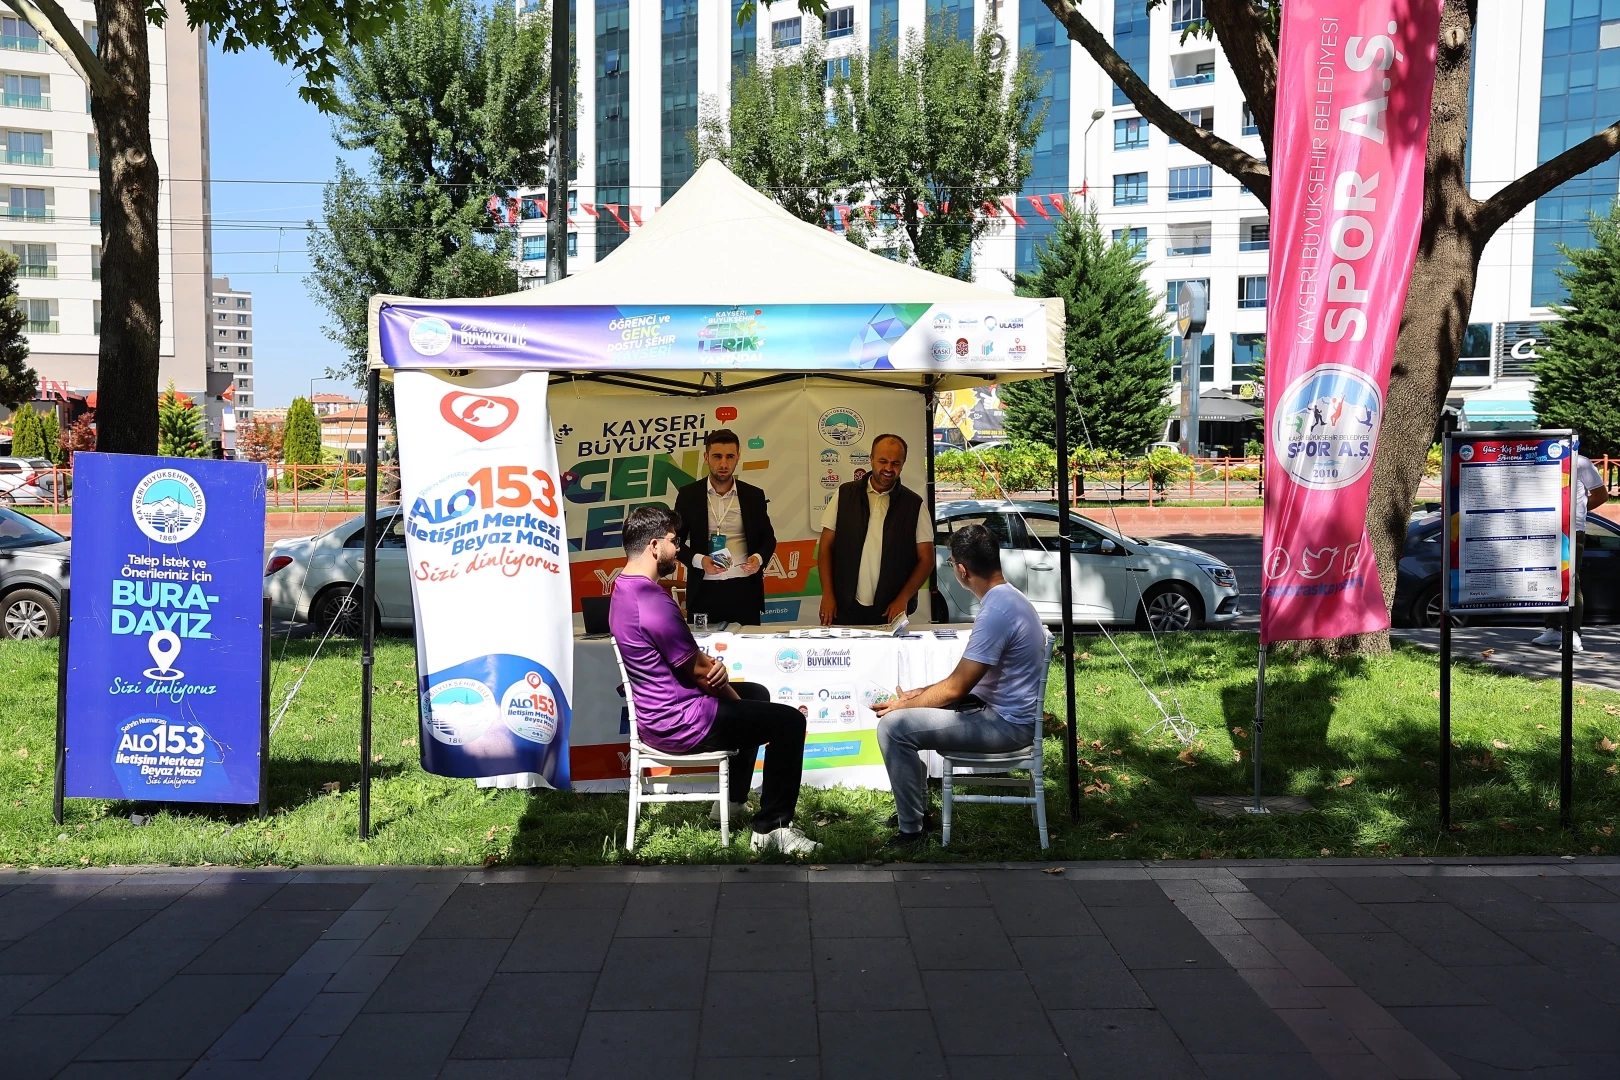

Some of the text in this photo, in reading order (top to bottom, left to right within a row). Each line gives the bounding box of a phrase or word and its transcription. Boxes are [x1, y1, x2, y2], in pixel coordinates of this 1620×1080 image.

[1297, 16, 1341, 345] KAYSERİ BÜYÜKŞEHİR BELEDİYESİ
[1323, 20, 1404, 342] SPOR A.Ş.
[608, 314, 671, 331] ÖĞRENCİ ve
[621, 325, 661, 341] GENÇ
[607, 334, 676, 353] DOSTU ŞEHİR
[603, 413, 706, 438] KAYSERİ
[577, 430, 709, 458] BÜYÜKŞEH
[1287, 441, 1331, 459] SPOR
[1313, 468, 1339, 478] 2010
[137, 487, 146, 521] KAYSERİ
[188, 482, 202, 525] BELEDİYESİ
[159, 534, 178, 542] 1869
[406, 517, 479, 546] İletişim
[483, 512, 561, 541] Merkezi
[451, 529, 560, 557] Beyaz Masa
[121, 564, 212, 583] Önerileriniz İçin
[128, 553, 207, 569] Talep İstek ve
[414, 547, 561, 582] Sizi dinliyoruz
[112, 579, 220, 610] BURA-
[111, 608, 212, 639] DAYIZ
[109, 676, 217, 704] Sizi dinliyoruz
[115, 751, 205, 767] İletişim Merkezi
[140, 764, 202, 778] Beyaz Masa
